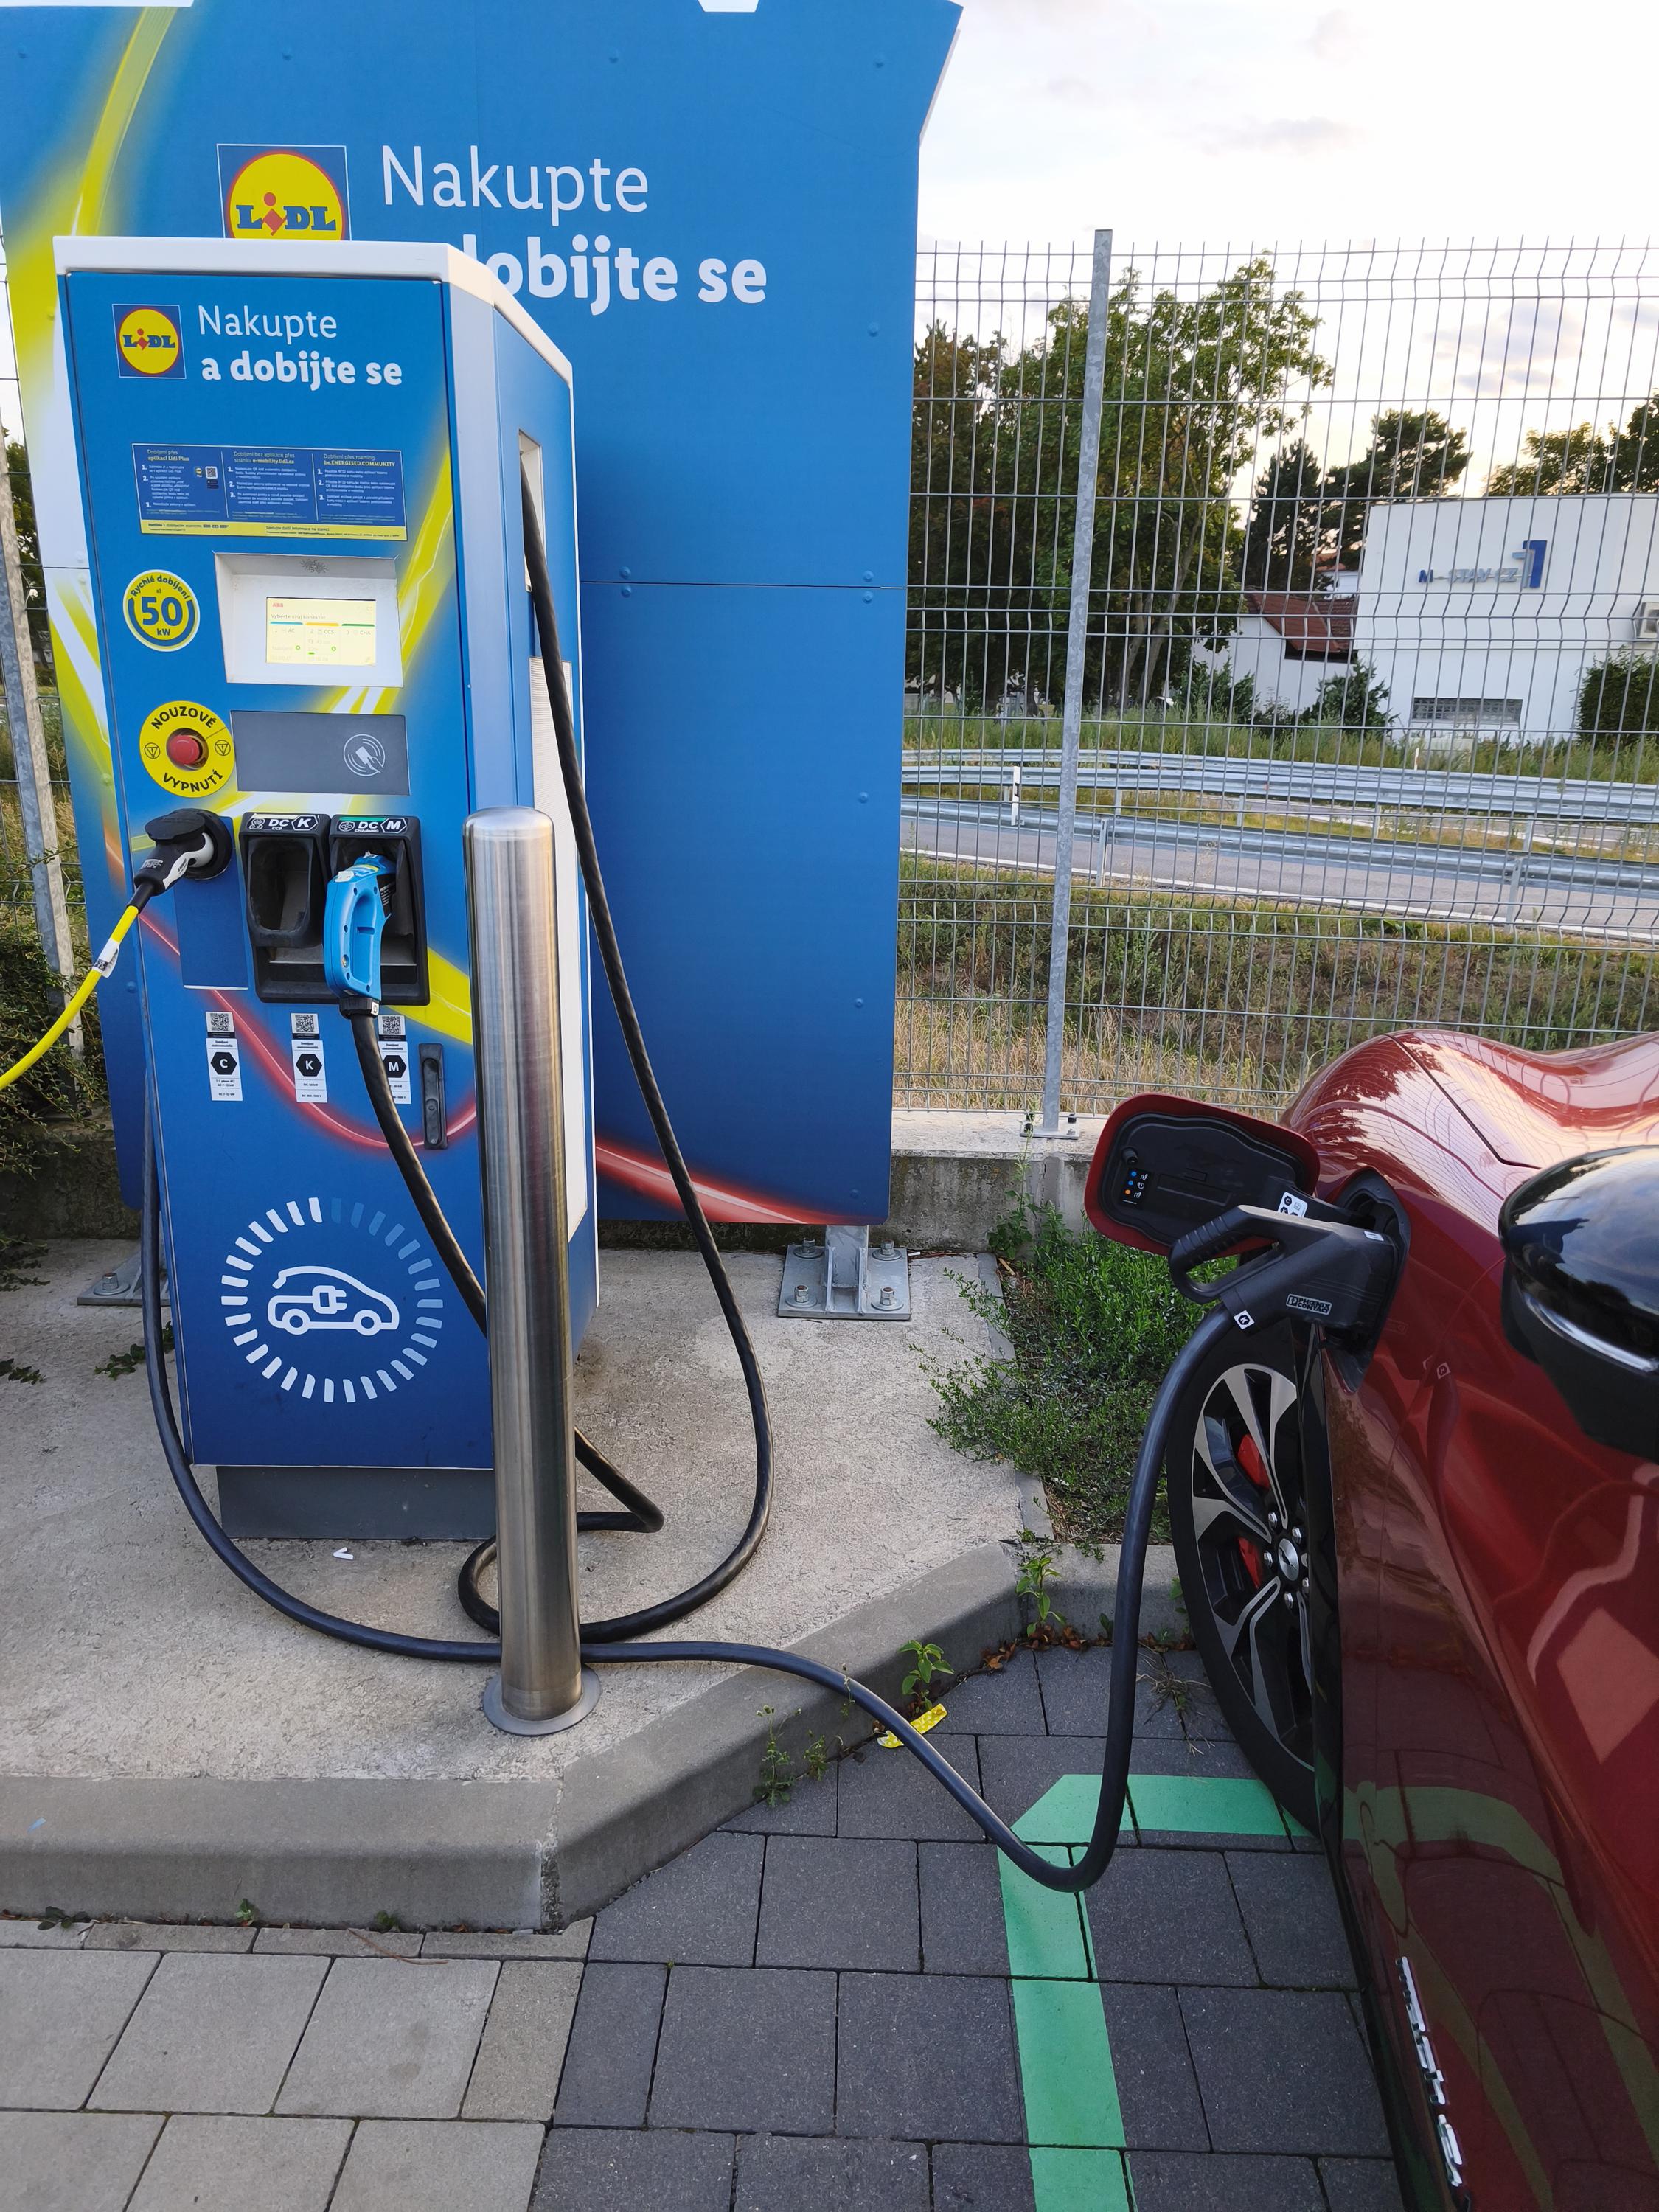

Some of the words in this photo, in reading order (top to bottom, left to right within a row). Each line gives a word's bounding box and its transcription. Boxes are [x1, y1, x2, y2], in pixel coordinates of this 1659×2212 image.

[382, 145, 648, 226] Nakupte
[698, 258, 767, 304] se
[198, 305, 337, 344] Nakupte
[201, 358, 221, 380] a
[230, 350, 355, 391] dobijte
[366, 362, 402, 386] se
[130, 575, 155, 597] Rychlé
[156, 575, 191, 599] dobíjení
[141, 596, 183, 627] 50
[150, 706, 217, 730] NOUZOVÉ
[163, 769, 223, 792] VYPNUTÍ
[268, 818, 290, 827] DC
[297, 818, 311, 828] K
[358, 821, 379, 830] DC
[386, 821, 401, 830] M
[220, 1059, 229, 1068] C
[305, 1060, 314, 1070] K
[389, 1062, 400, 1071] M
